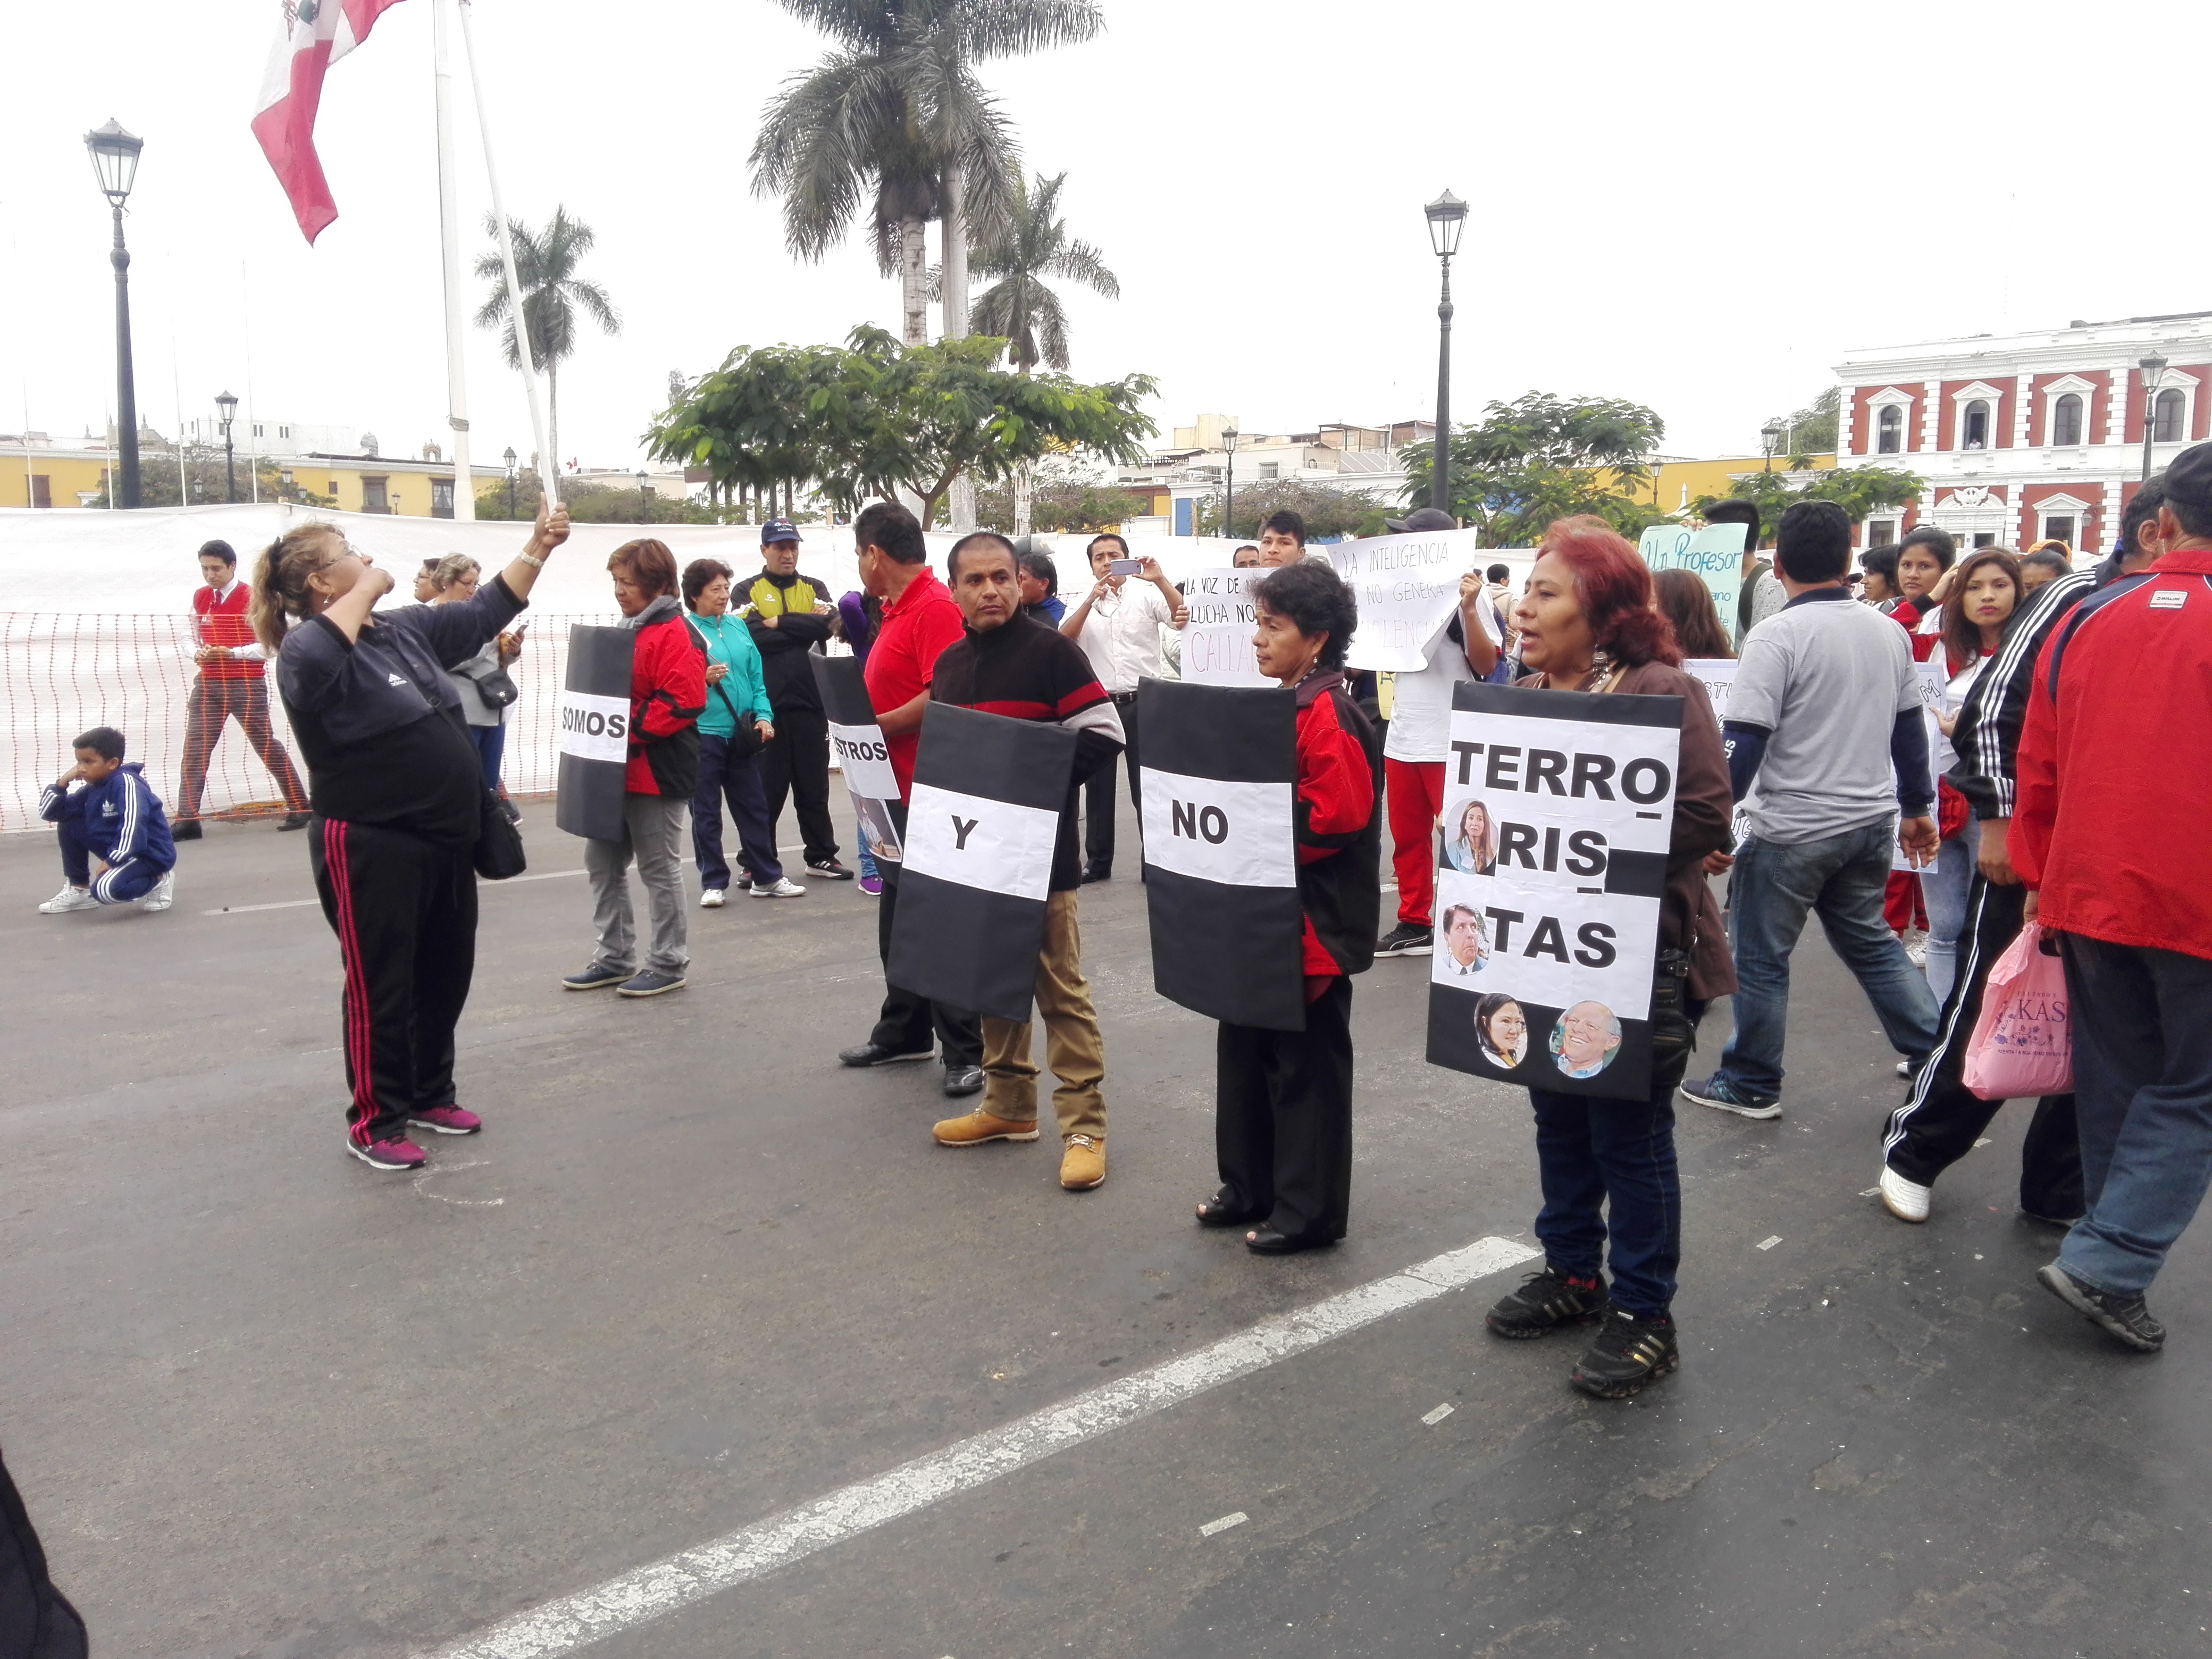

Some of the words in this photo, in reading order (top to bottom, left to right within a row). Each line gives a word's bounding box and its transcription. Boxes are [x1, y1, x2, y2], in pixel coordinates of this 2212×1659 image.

[1369, 542, 1448, 572] INTELIGENCIA
[1186, 577, 1195, 595] LA
[1201, 577, 1218, 594] VOZ
[1227, 577, 1239, 594] DE
[1367, 584, 1382, 605] NO
[1393, 582, 1444, 601] GENERA
[1191, 604, 1229, 624] LUCHA
[1236, 604, 1255, 623] NO
[563, 706, 625, 738] SOMOS
[833, 735, 888, 761] STROS
[951, 815, 979, 850] Y
[1171, 800, 1228, 844] NO
[1485, 906, 1617, 968] TAS
